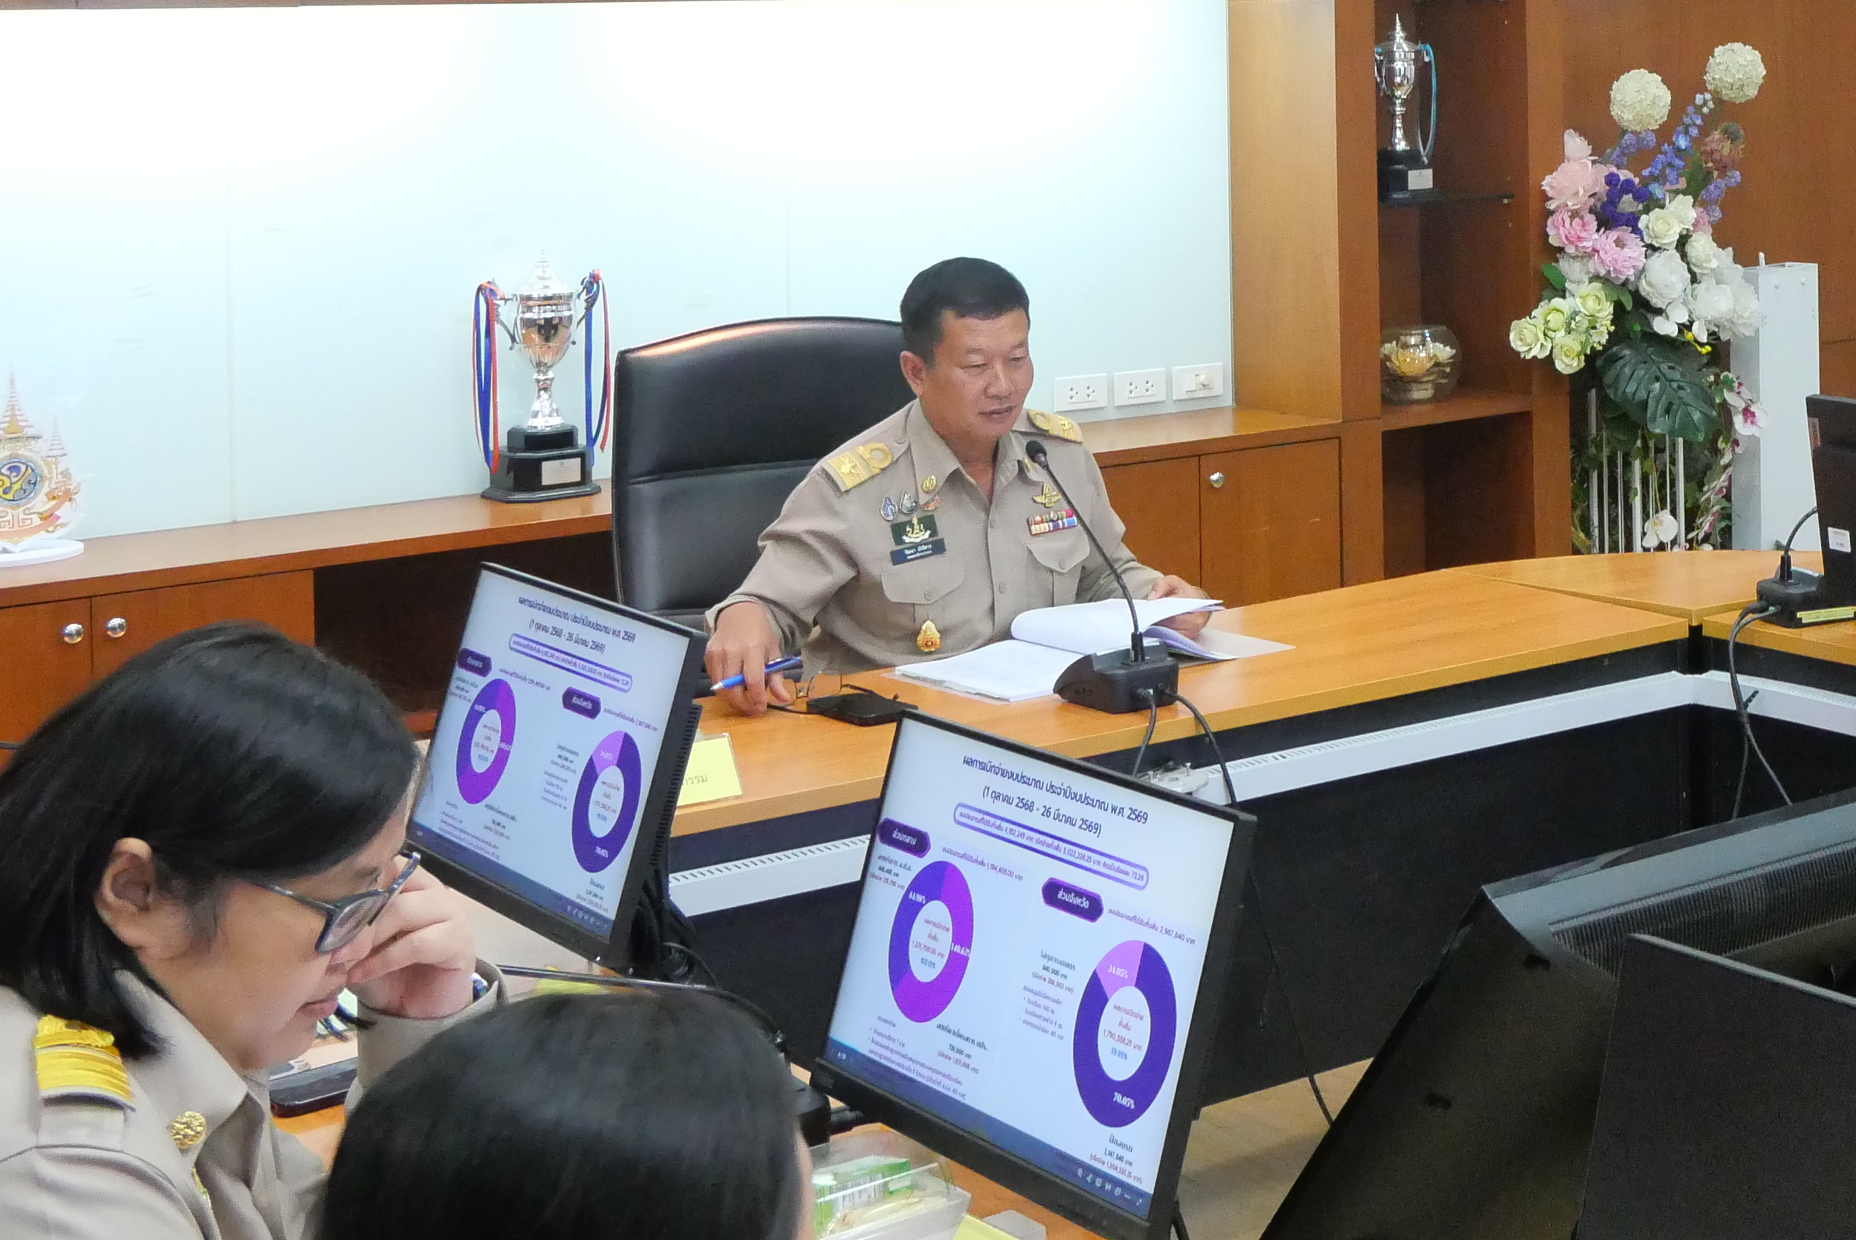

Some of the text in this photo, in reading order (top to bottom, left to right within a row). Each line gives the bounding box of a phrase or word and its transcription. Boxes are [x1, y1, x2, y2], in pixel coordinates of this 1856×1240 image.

[621, 629, 636, 643] 2569
[962, 755, 1045, 790] ผลการเบิกจ่ายงบประมาณ
[1045, 779, 1109, 811] ประจำปีงบประมาณ
[1126, 806, 1149, 825] 2569
[989, 789, 1014, 805] ตุลาคม
[1014, 795, 1035, 813] 2568
[1040, 804, 1052, 819] 26
[1052, 807, 1078, 827] มีนาคม
[1077, 817, 1102, 838] 2569)
[1056, 887, 1090, 910] ส่วนจังหวัด
[1112, 1091, 1135, 1111] 70.05%
